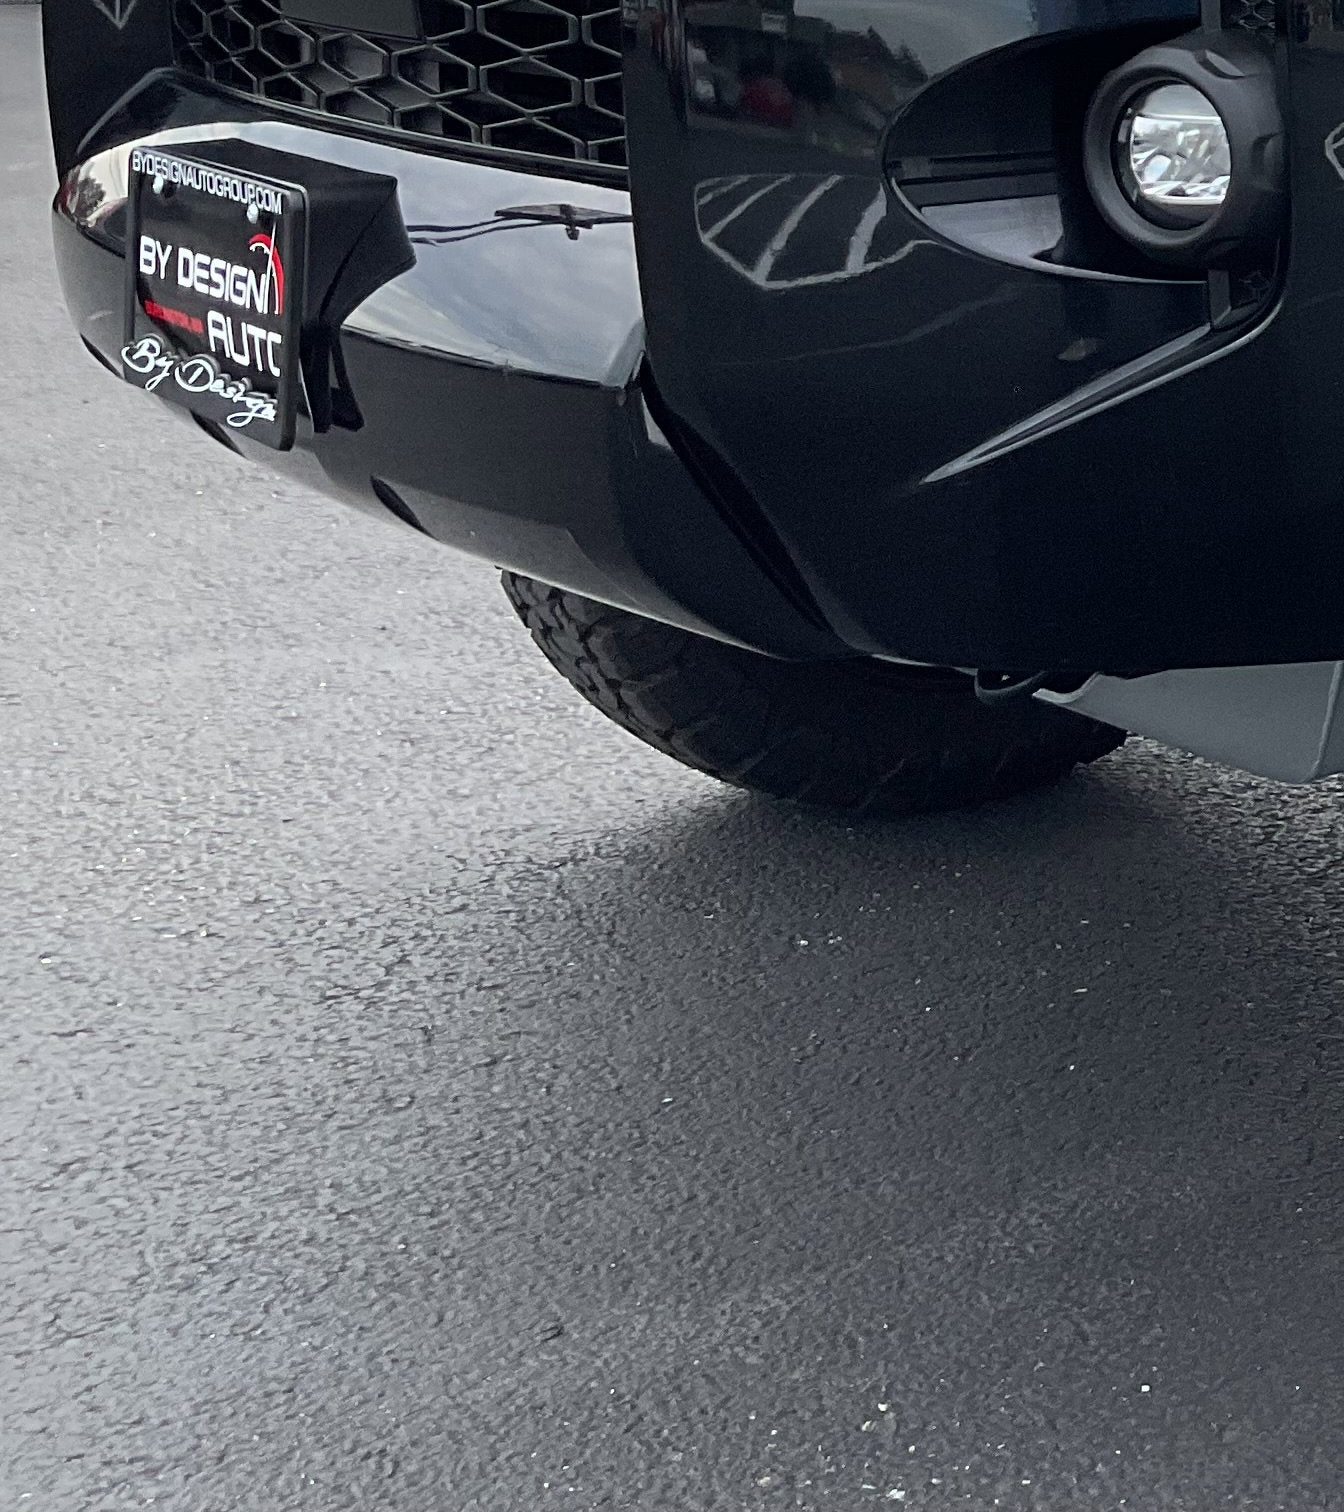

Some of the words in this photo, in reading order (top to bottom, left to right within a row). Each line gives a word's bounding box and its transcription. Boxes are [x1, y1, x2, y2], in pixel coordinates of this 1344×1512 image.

[139, 235, 173, 280] BY
[177, 247, 267, 314] DESIGN
[121, 336, 174, 391] By
